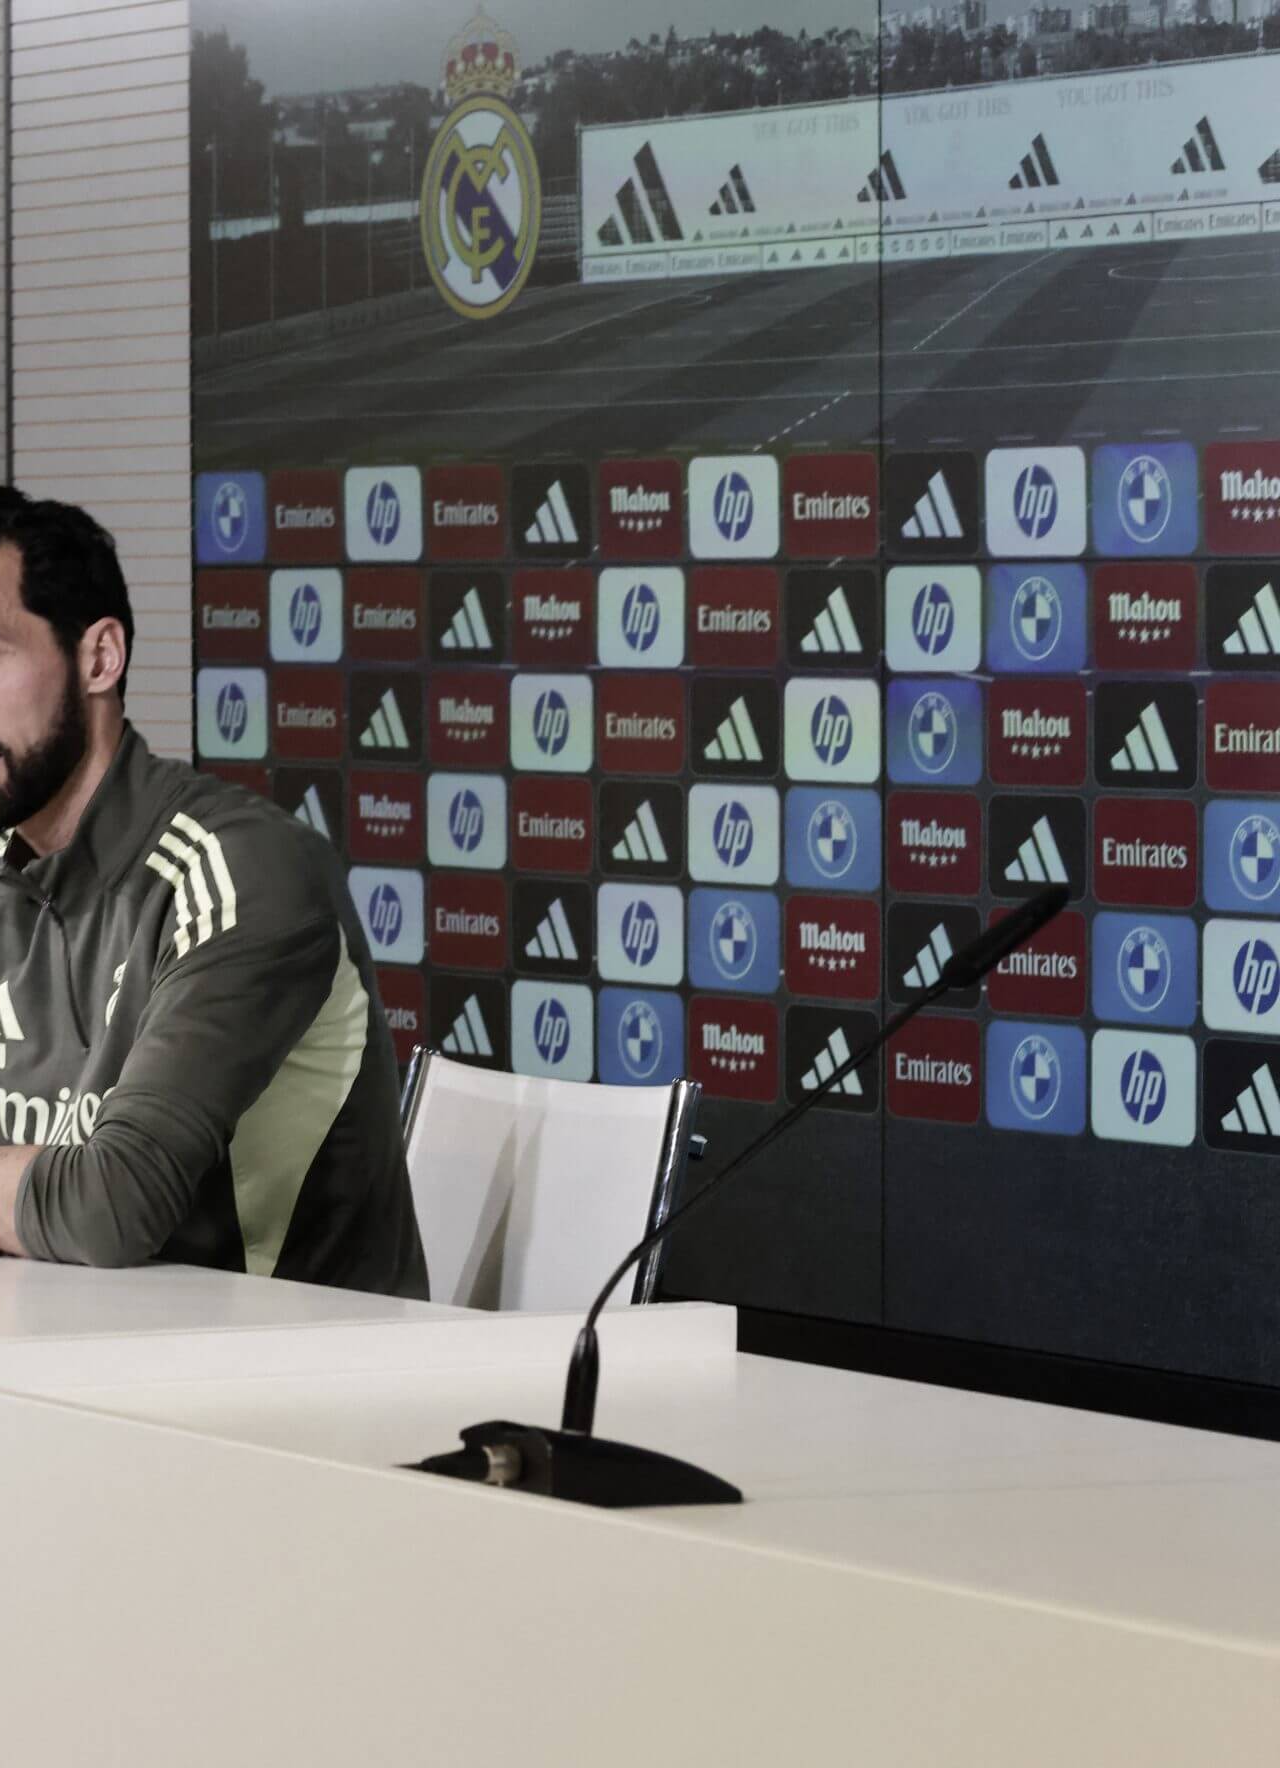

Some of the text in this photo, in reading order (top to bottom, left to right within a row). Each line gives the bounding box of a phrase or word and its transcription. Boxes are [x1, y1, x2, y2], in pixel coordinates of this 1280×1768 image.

[370, 481, 398, 546] hp
[433, 500, 498, 526] Emirates
[610, 485, 670, 512] Mahou
[719, 472, 750, 542] hp
[793, 492, 870, 520] Emirates
[1018, 465, 1054, 540] hp
[275, 504, 335, 528] Emirates
[203, 605, 260, 628] Emirates
[293, 584, 318, 647] hp
[354, 604, 416, 629] Emirates
[524, 595, 580, 621] Mahou
[626, 585, 656, 652] hp
[698, 605, 771, 632] Emirates
[916, 584, 951, 656] hp
[1109, 592, 1181, 621] Mahou
[219, 683, 245, 744] hp
[277, 703, 336, 728] Emirates
[439, 698, 493, 724] Mahou
[536, 690, 566, 756] hp
[606, 713, 675, 739] Emirates
[1002, 709, 1070, 738] Mahou
[816, 696, 848, 766] hp
[359, 795, 411, 820] Mahou
[452, 790, 482, 853] hp
[519, 812, 585, 839] Emirates
[718, 801, 750, 867] hp
[901, 820, 966, 848] Mahou
[1103, 838, 1187, 868] Emirates
[372, 884, 399, 946] hp
[436, 908, 499, 936] Emirates
[625, 901, 655, 966] hp
[800, 922, 865, 952] Mahou
[1238, 939, 1277, 1015] hp
[384, 1008, 417, 1030] rates
[538, 998, 567, 1064] hp
[703, 1024, 764, 1054] Mahou
[896, 1053, 972, 1085] Emirates
[1126, 1049, 1163, 1124] hp
